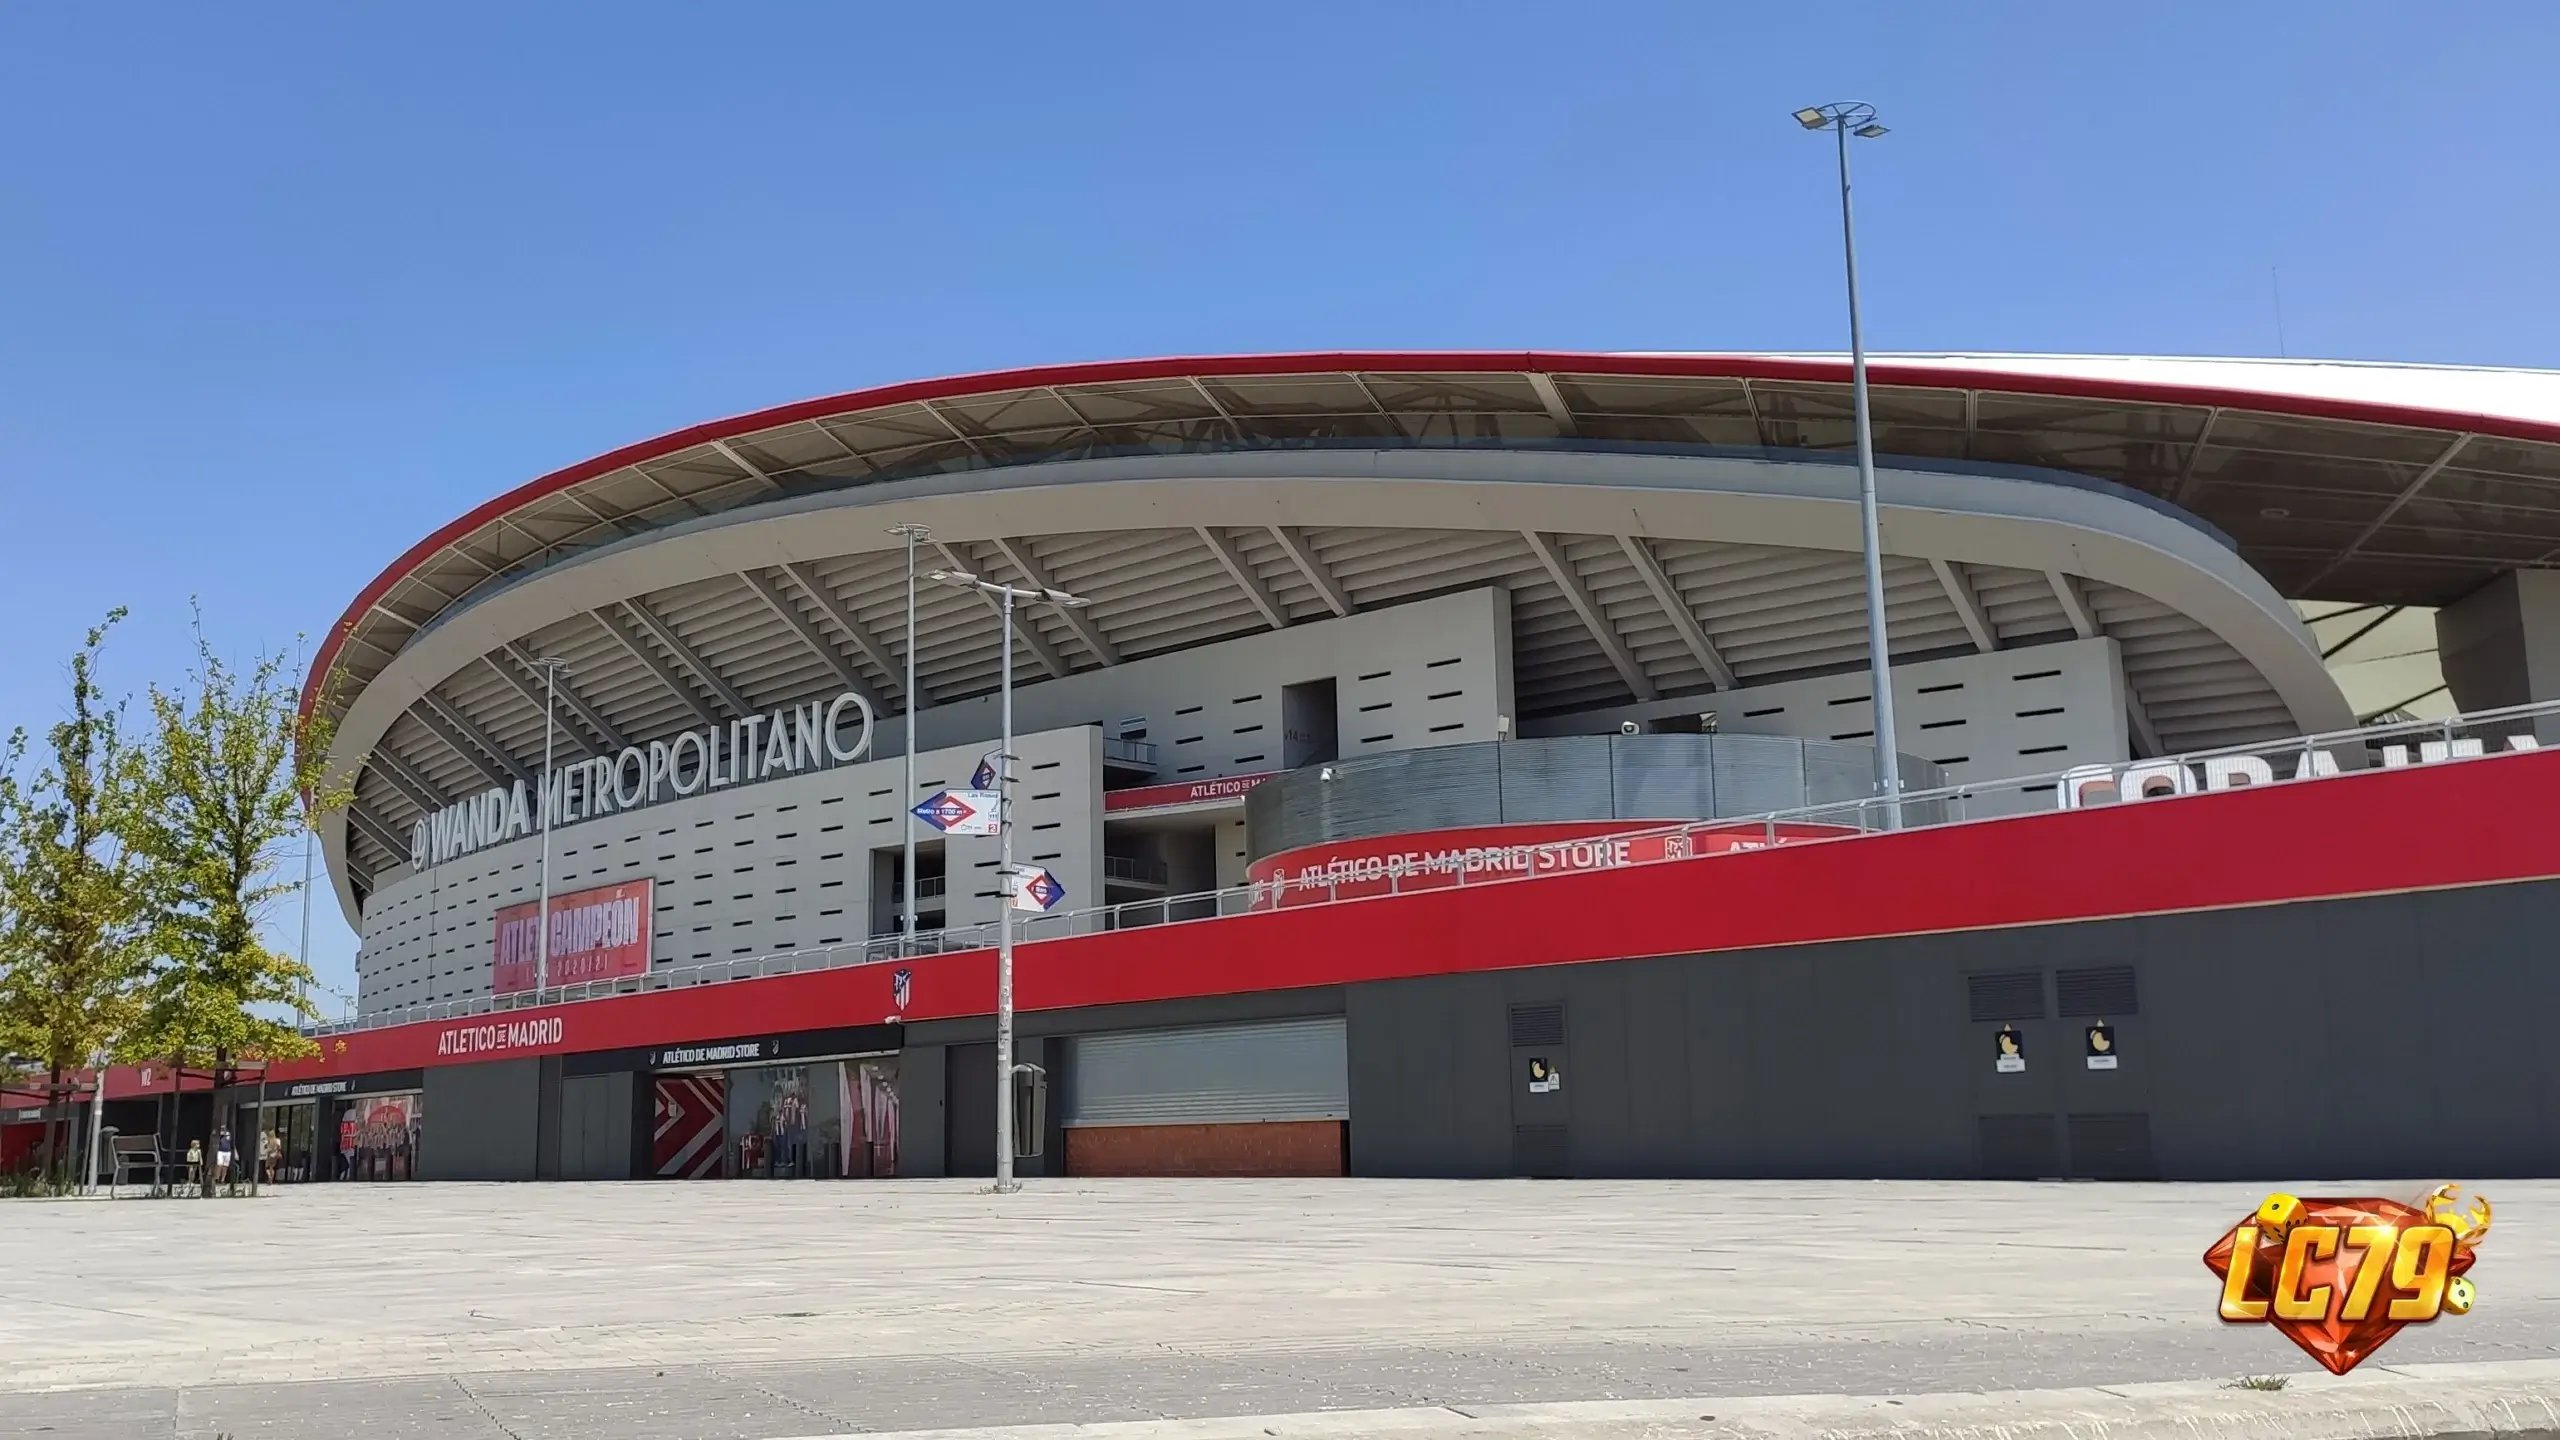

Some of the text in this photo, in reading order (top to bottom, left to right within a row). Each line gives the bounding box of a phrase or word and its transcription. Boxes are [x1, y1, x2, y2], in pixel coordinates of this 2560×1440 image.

[431, 692, 874, 864] WANDA METROPOLITANO
[1190, 780, 1241, 798] ATLÉTICO
[1299, 841, 1631, 892] ATLÉTICO DE MADRID STORE
[500, 915, 541, 966] ATLET
[438, 1025, 496, 1056] ATLETICO
[507, 1017, 563, 1049] MADRID
[662, 1043, 760, 1065] ATLÉTICO DE MADRID STORE
